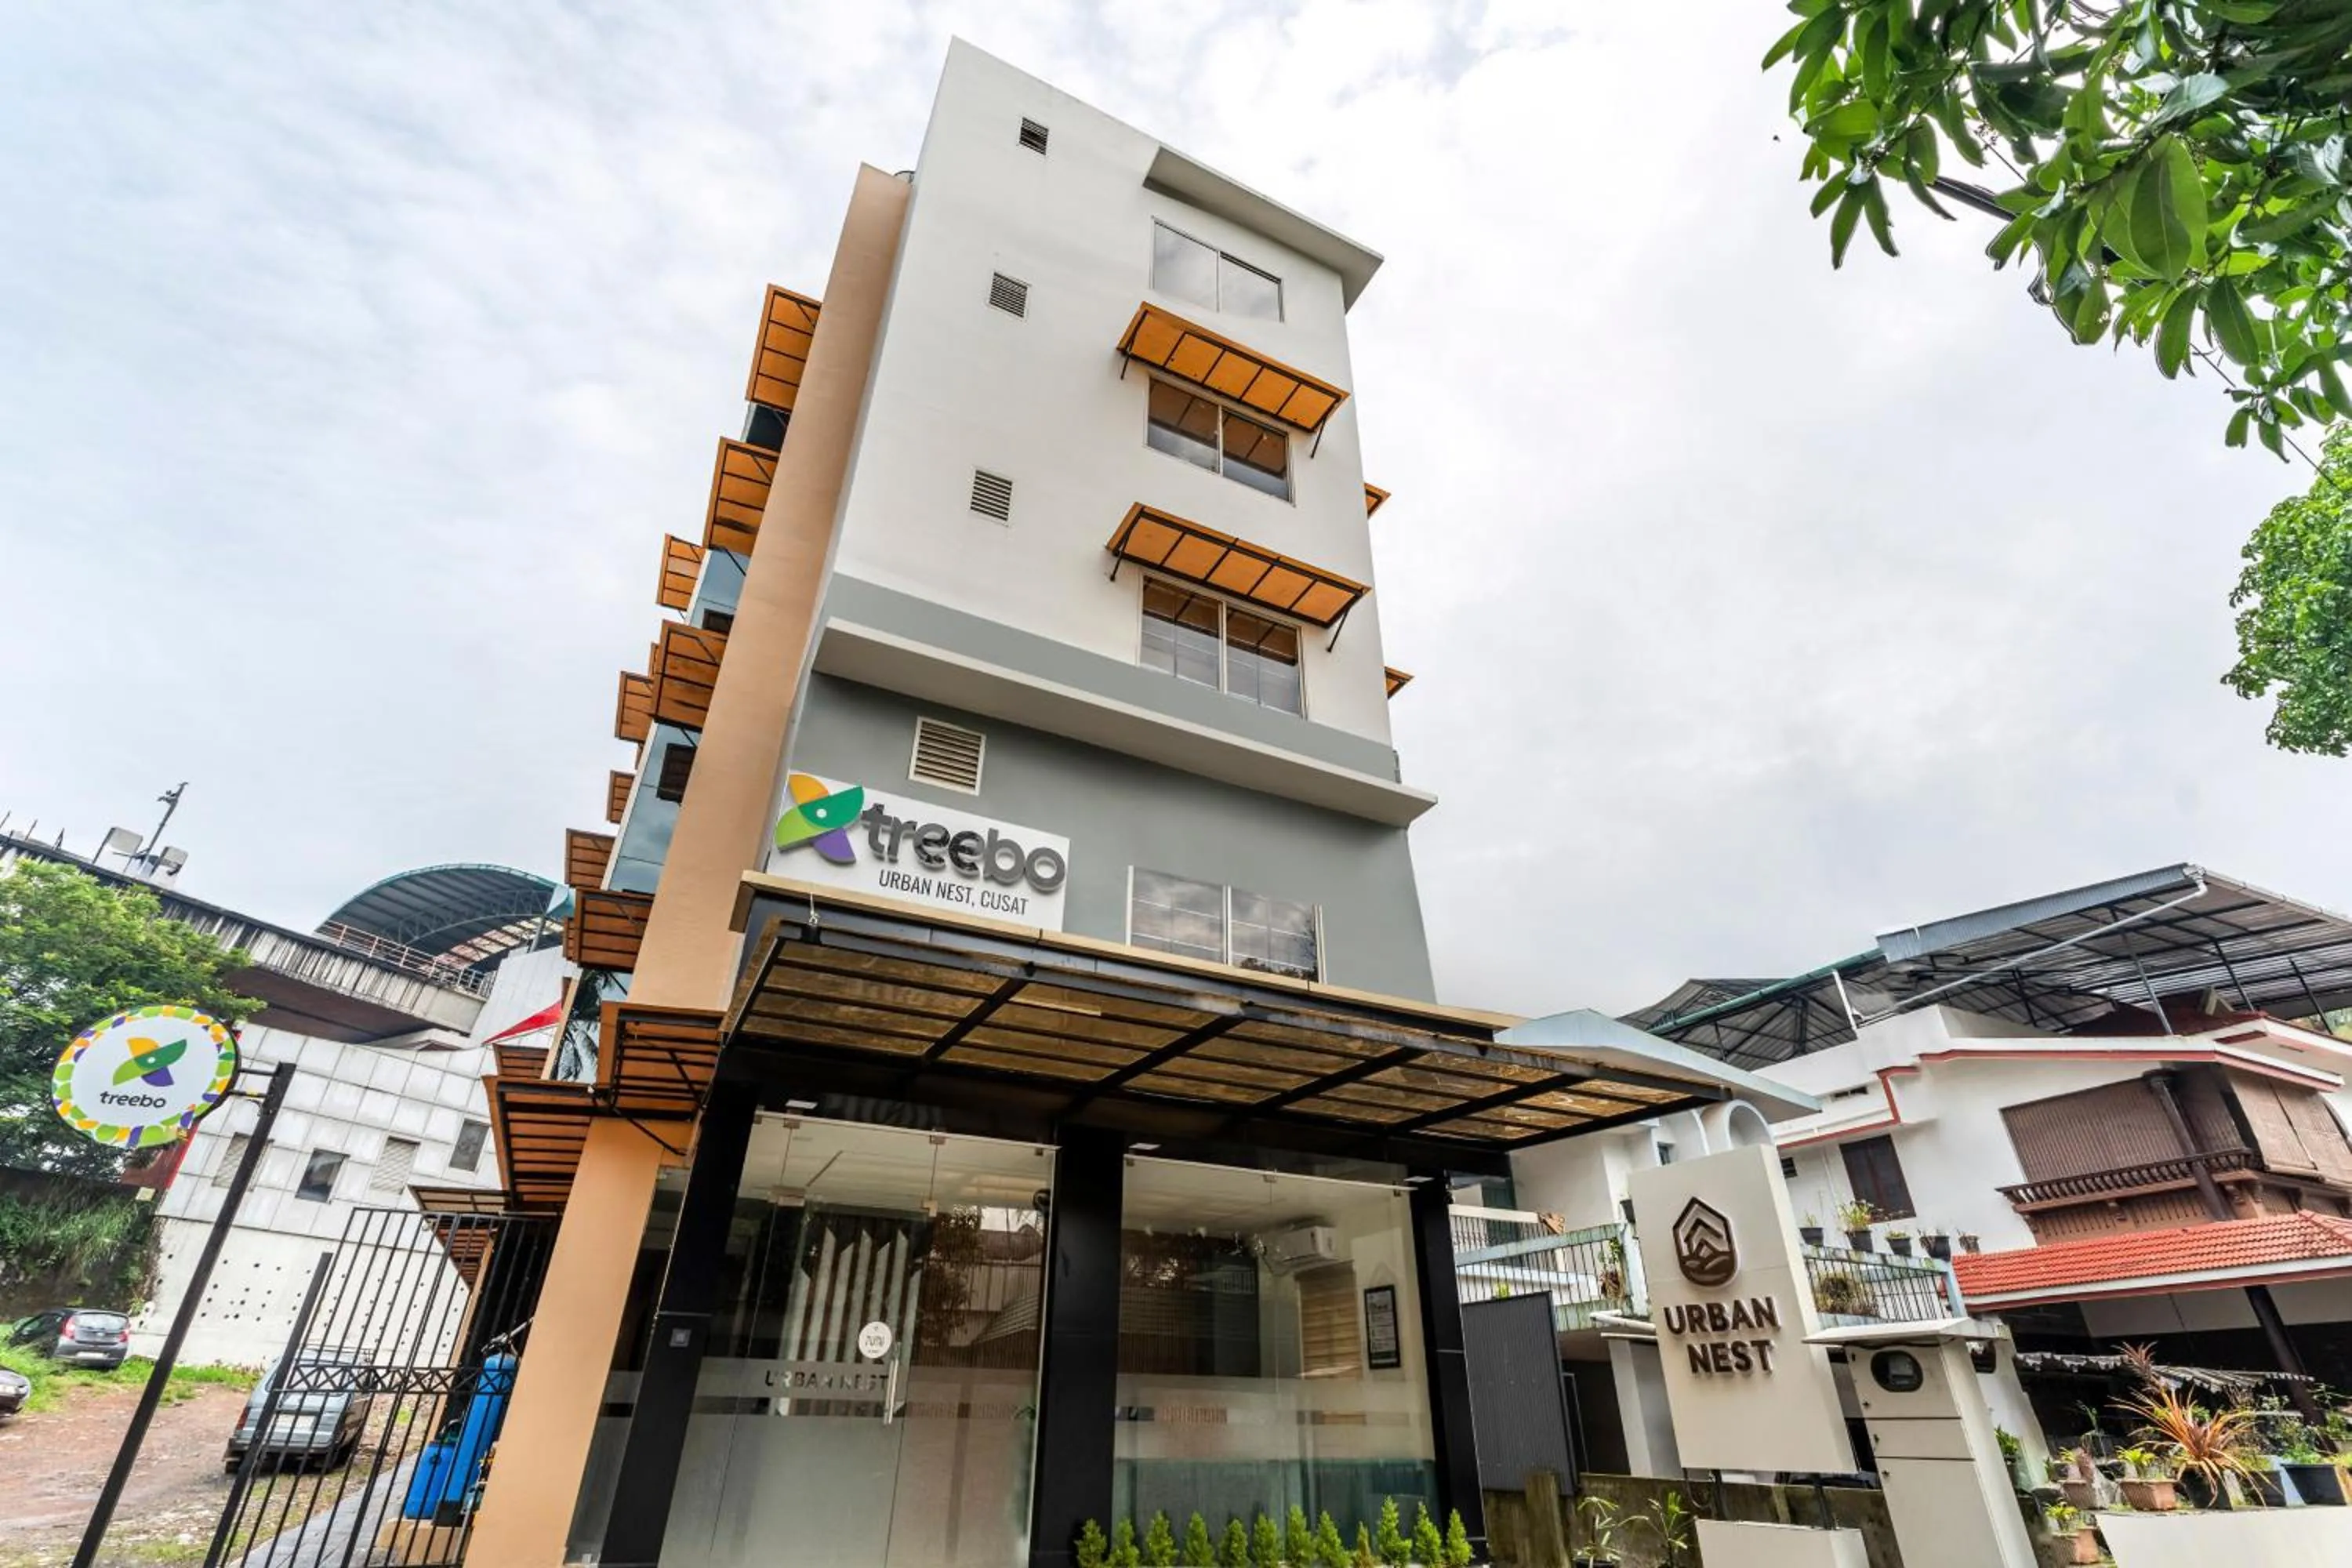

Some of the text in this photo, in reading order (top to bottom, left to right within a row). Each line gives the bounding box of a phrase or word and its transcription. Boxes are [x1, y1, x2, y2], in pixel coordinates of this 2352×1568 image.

[862, 803, 1065, 891] treebo
[879, 869, 1029, 915] URBAN NEST, CUSAT
[100, 1091, 166, 1109] treebo
[1664, 1296, 1781, 1335] URBAN
[1687, 1340, 1774, 1374] NEST
